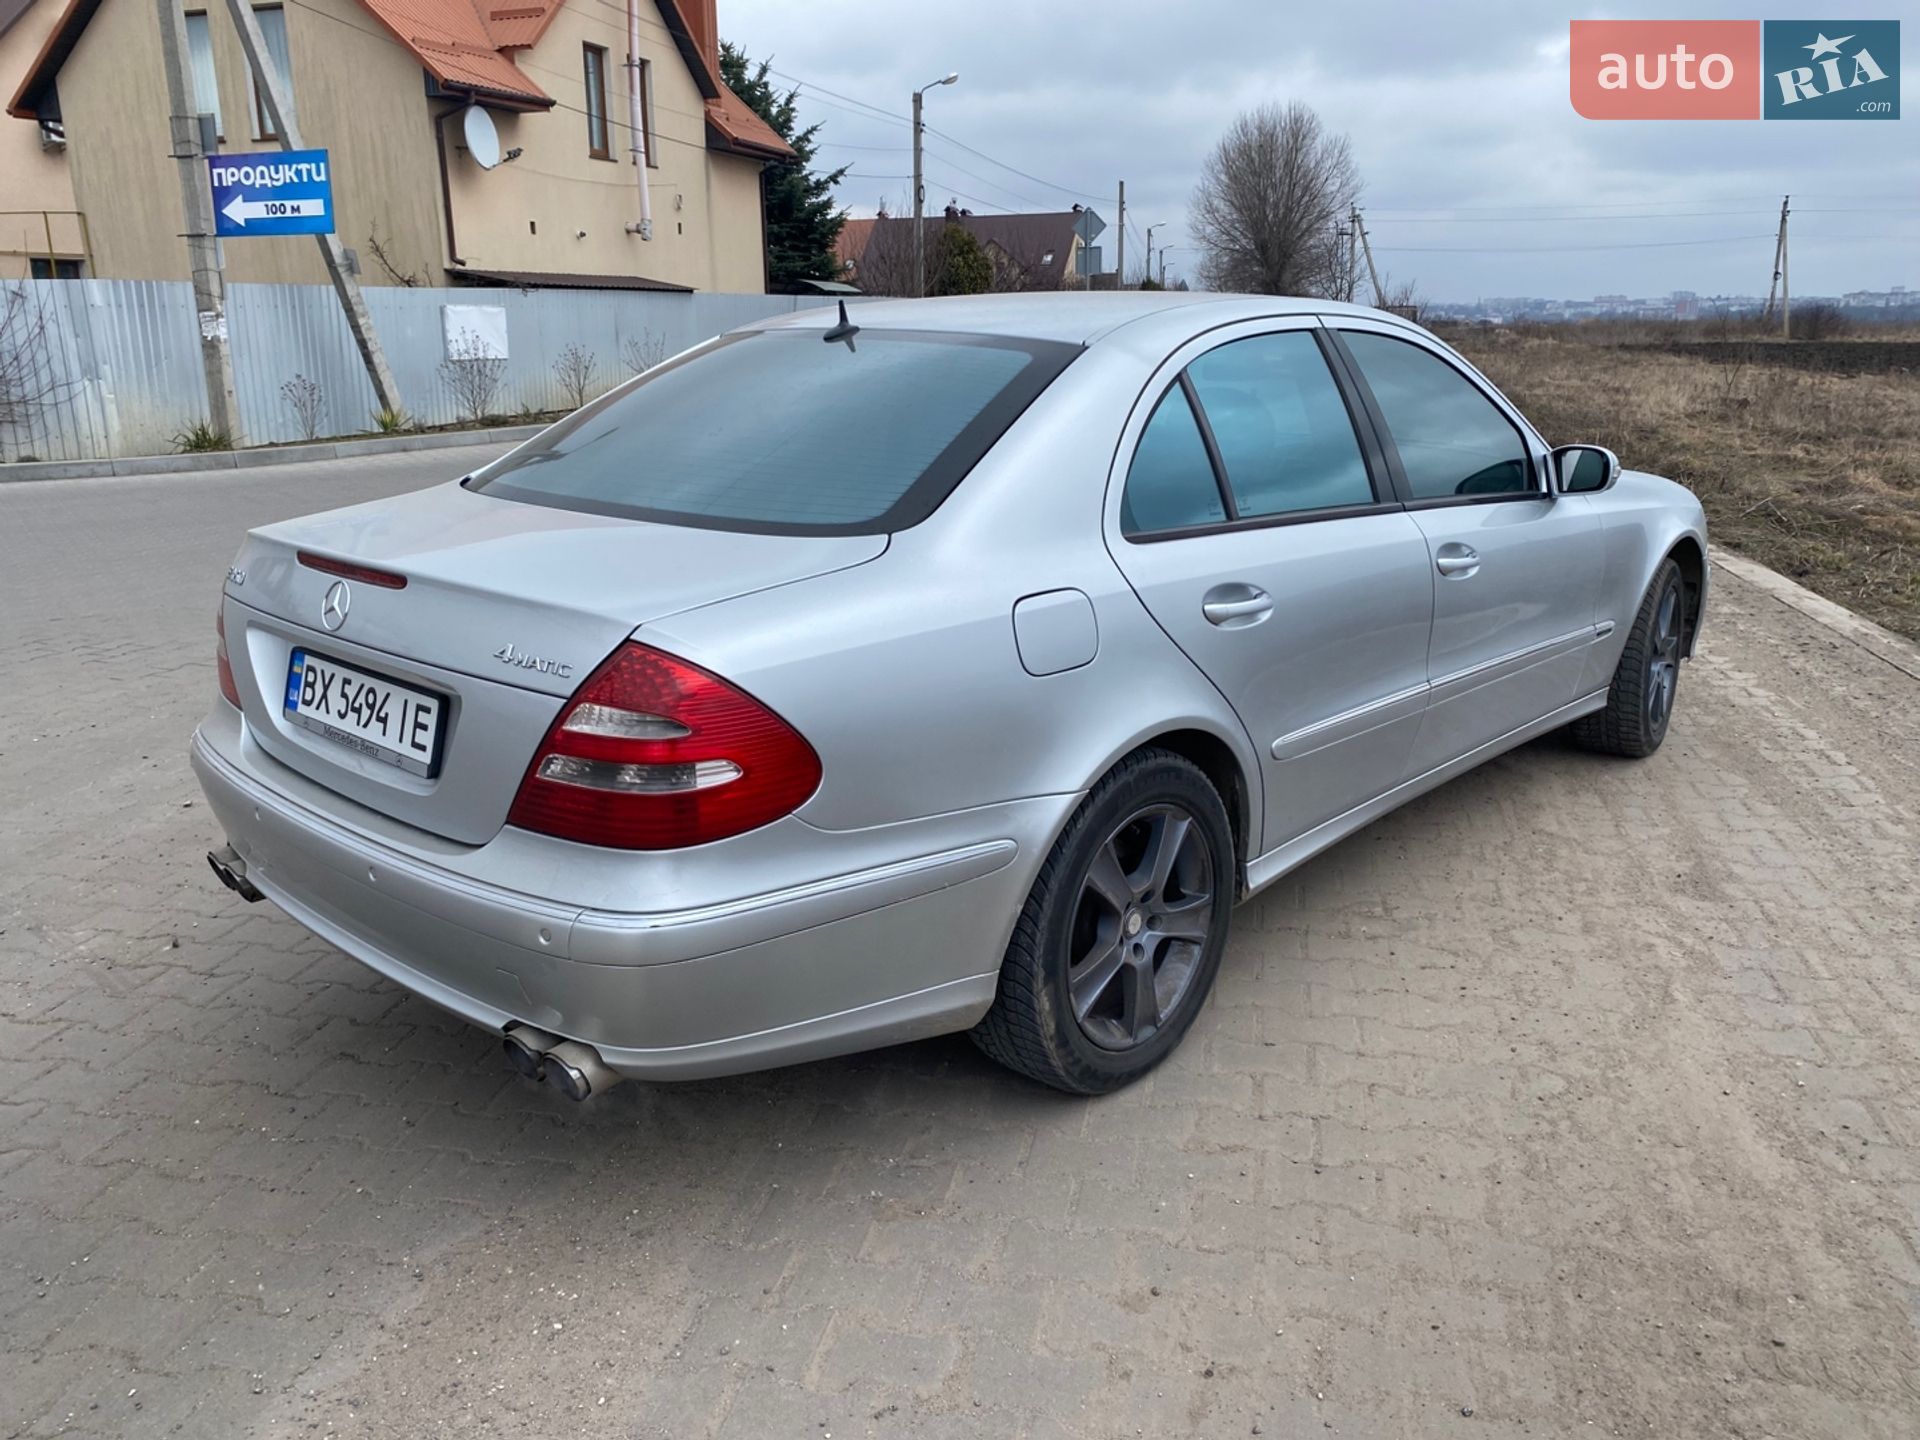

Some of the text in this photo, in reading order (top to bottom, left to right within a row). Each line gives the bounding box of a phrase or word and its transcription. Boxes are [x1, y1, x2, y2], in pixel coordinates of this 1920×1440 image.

[212, 162, 326, 188] ПРОДУКТИ
[264, 203, 286, 215] 100
[493, 643, 574, 678] 4MATIC
[301, 664, 432, 753] BX 5494 IE
